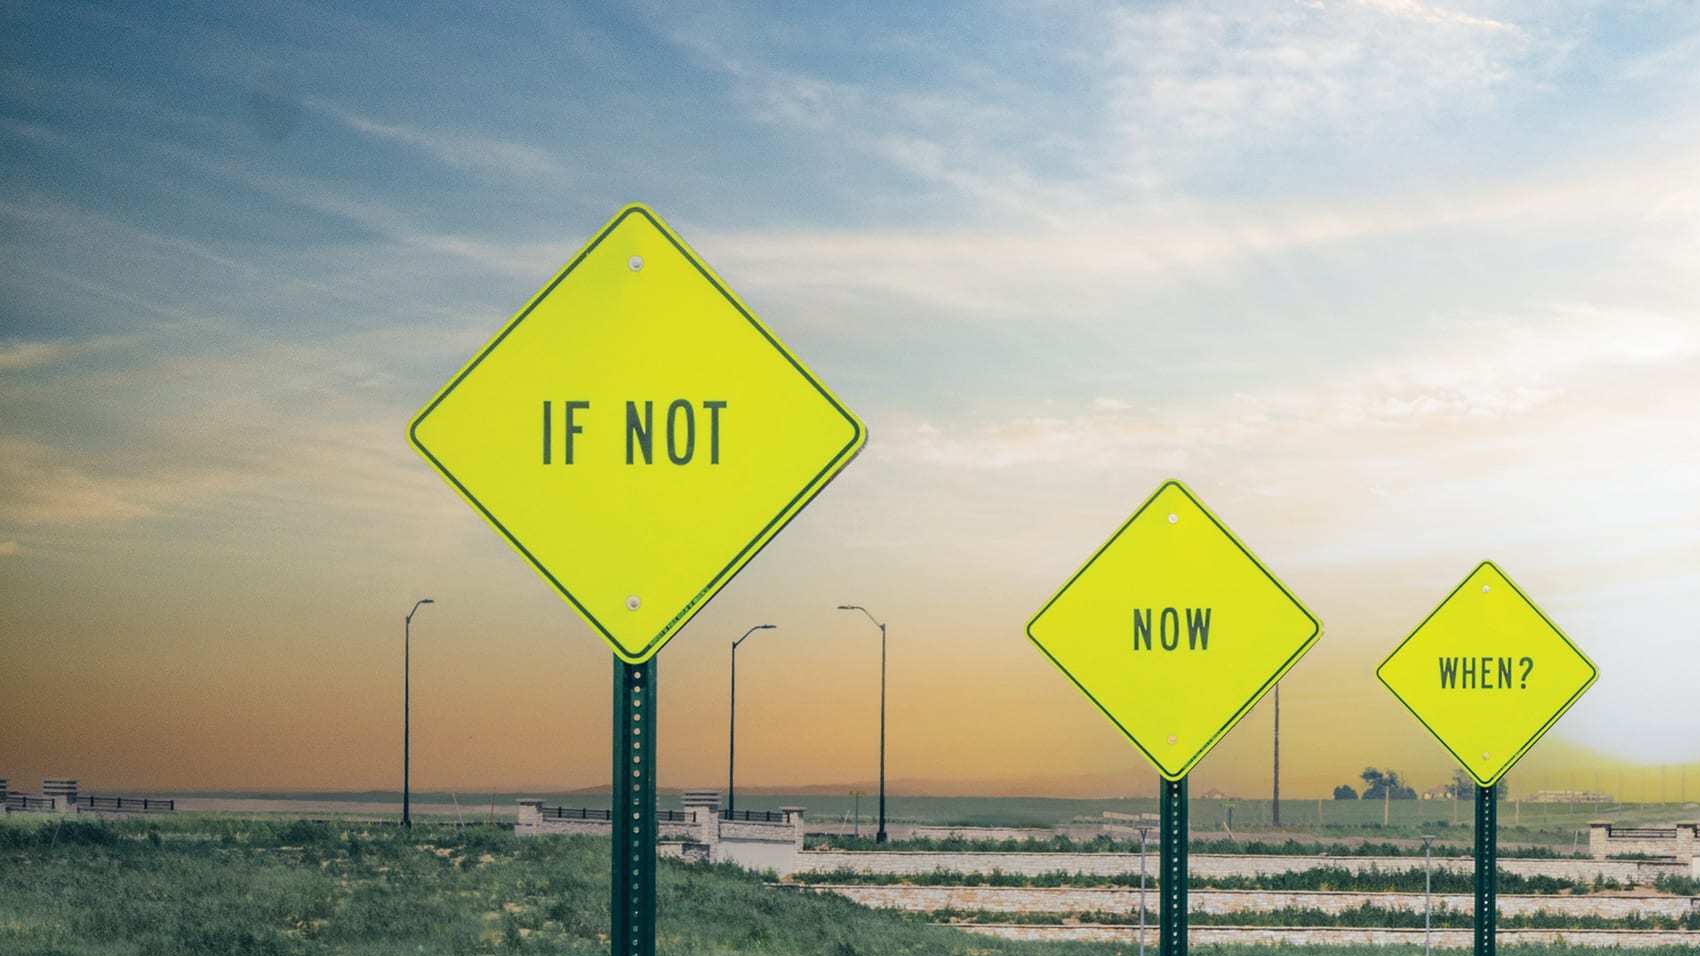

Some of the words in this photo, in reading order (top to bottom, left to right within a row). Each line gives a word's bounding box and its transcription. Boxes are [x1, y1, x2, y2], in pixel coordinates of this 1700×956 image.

[542, 400, 590, 465] IF
[625, 398, 728, 466] NOT
[1133, 606, 1212, 652] NOW
[1438, 656, 1534, 690] WHEN?
